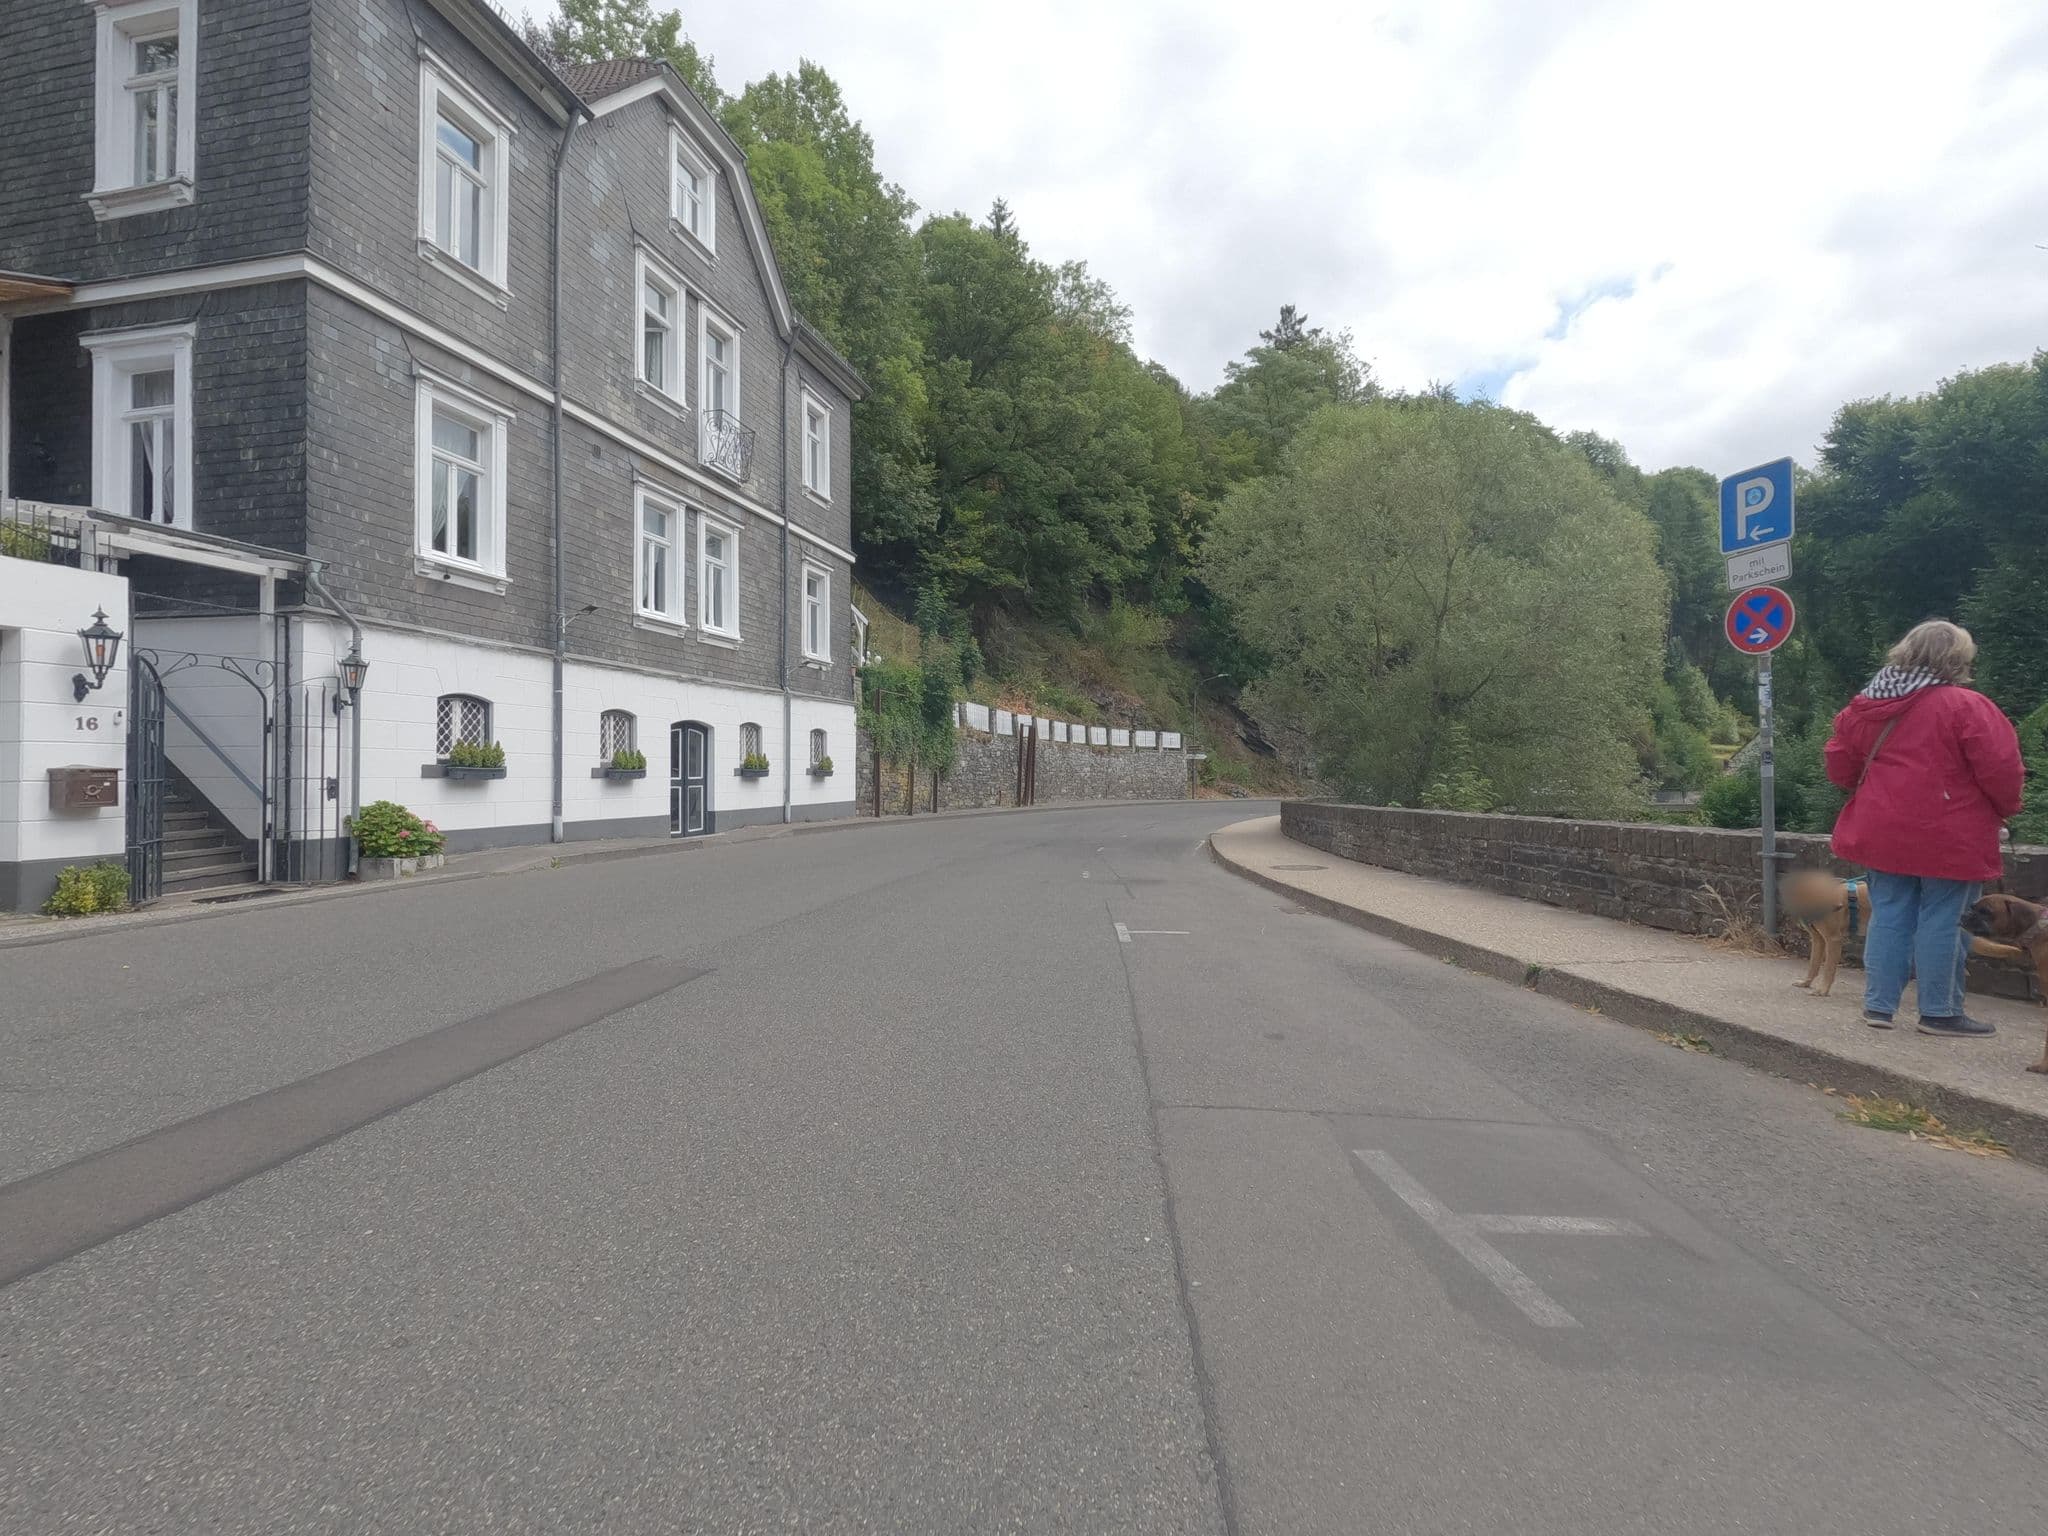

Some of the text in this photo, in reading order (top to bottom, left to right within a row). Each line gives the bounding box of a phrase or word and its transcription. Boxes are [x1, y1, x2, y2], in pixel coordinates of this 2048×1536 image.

[1737, 476, 1774, 540] P
[1749, 555, 1765, 568] mit
[1732, 563, 1785, 583] Parkschein
[75, 716, 99, 731] 16
